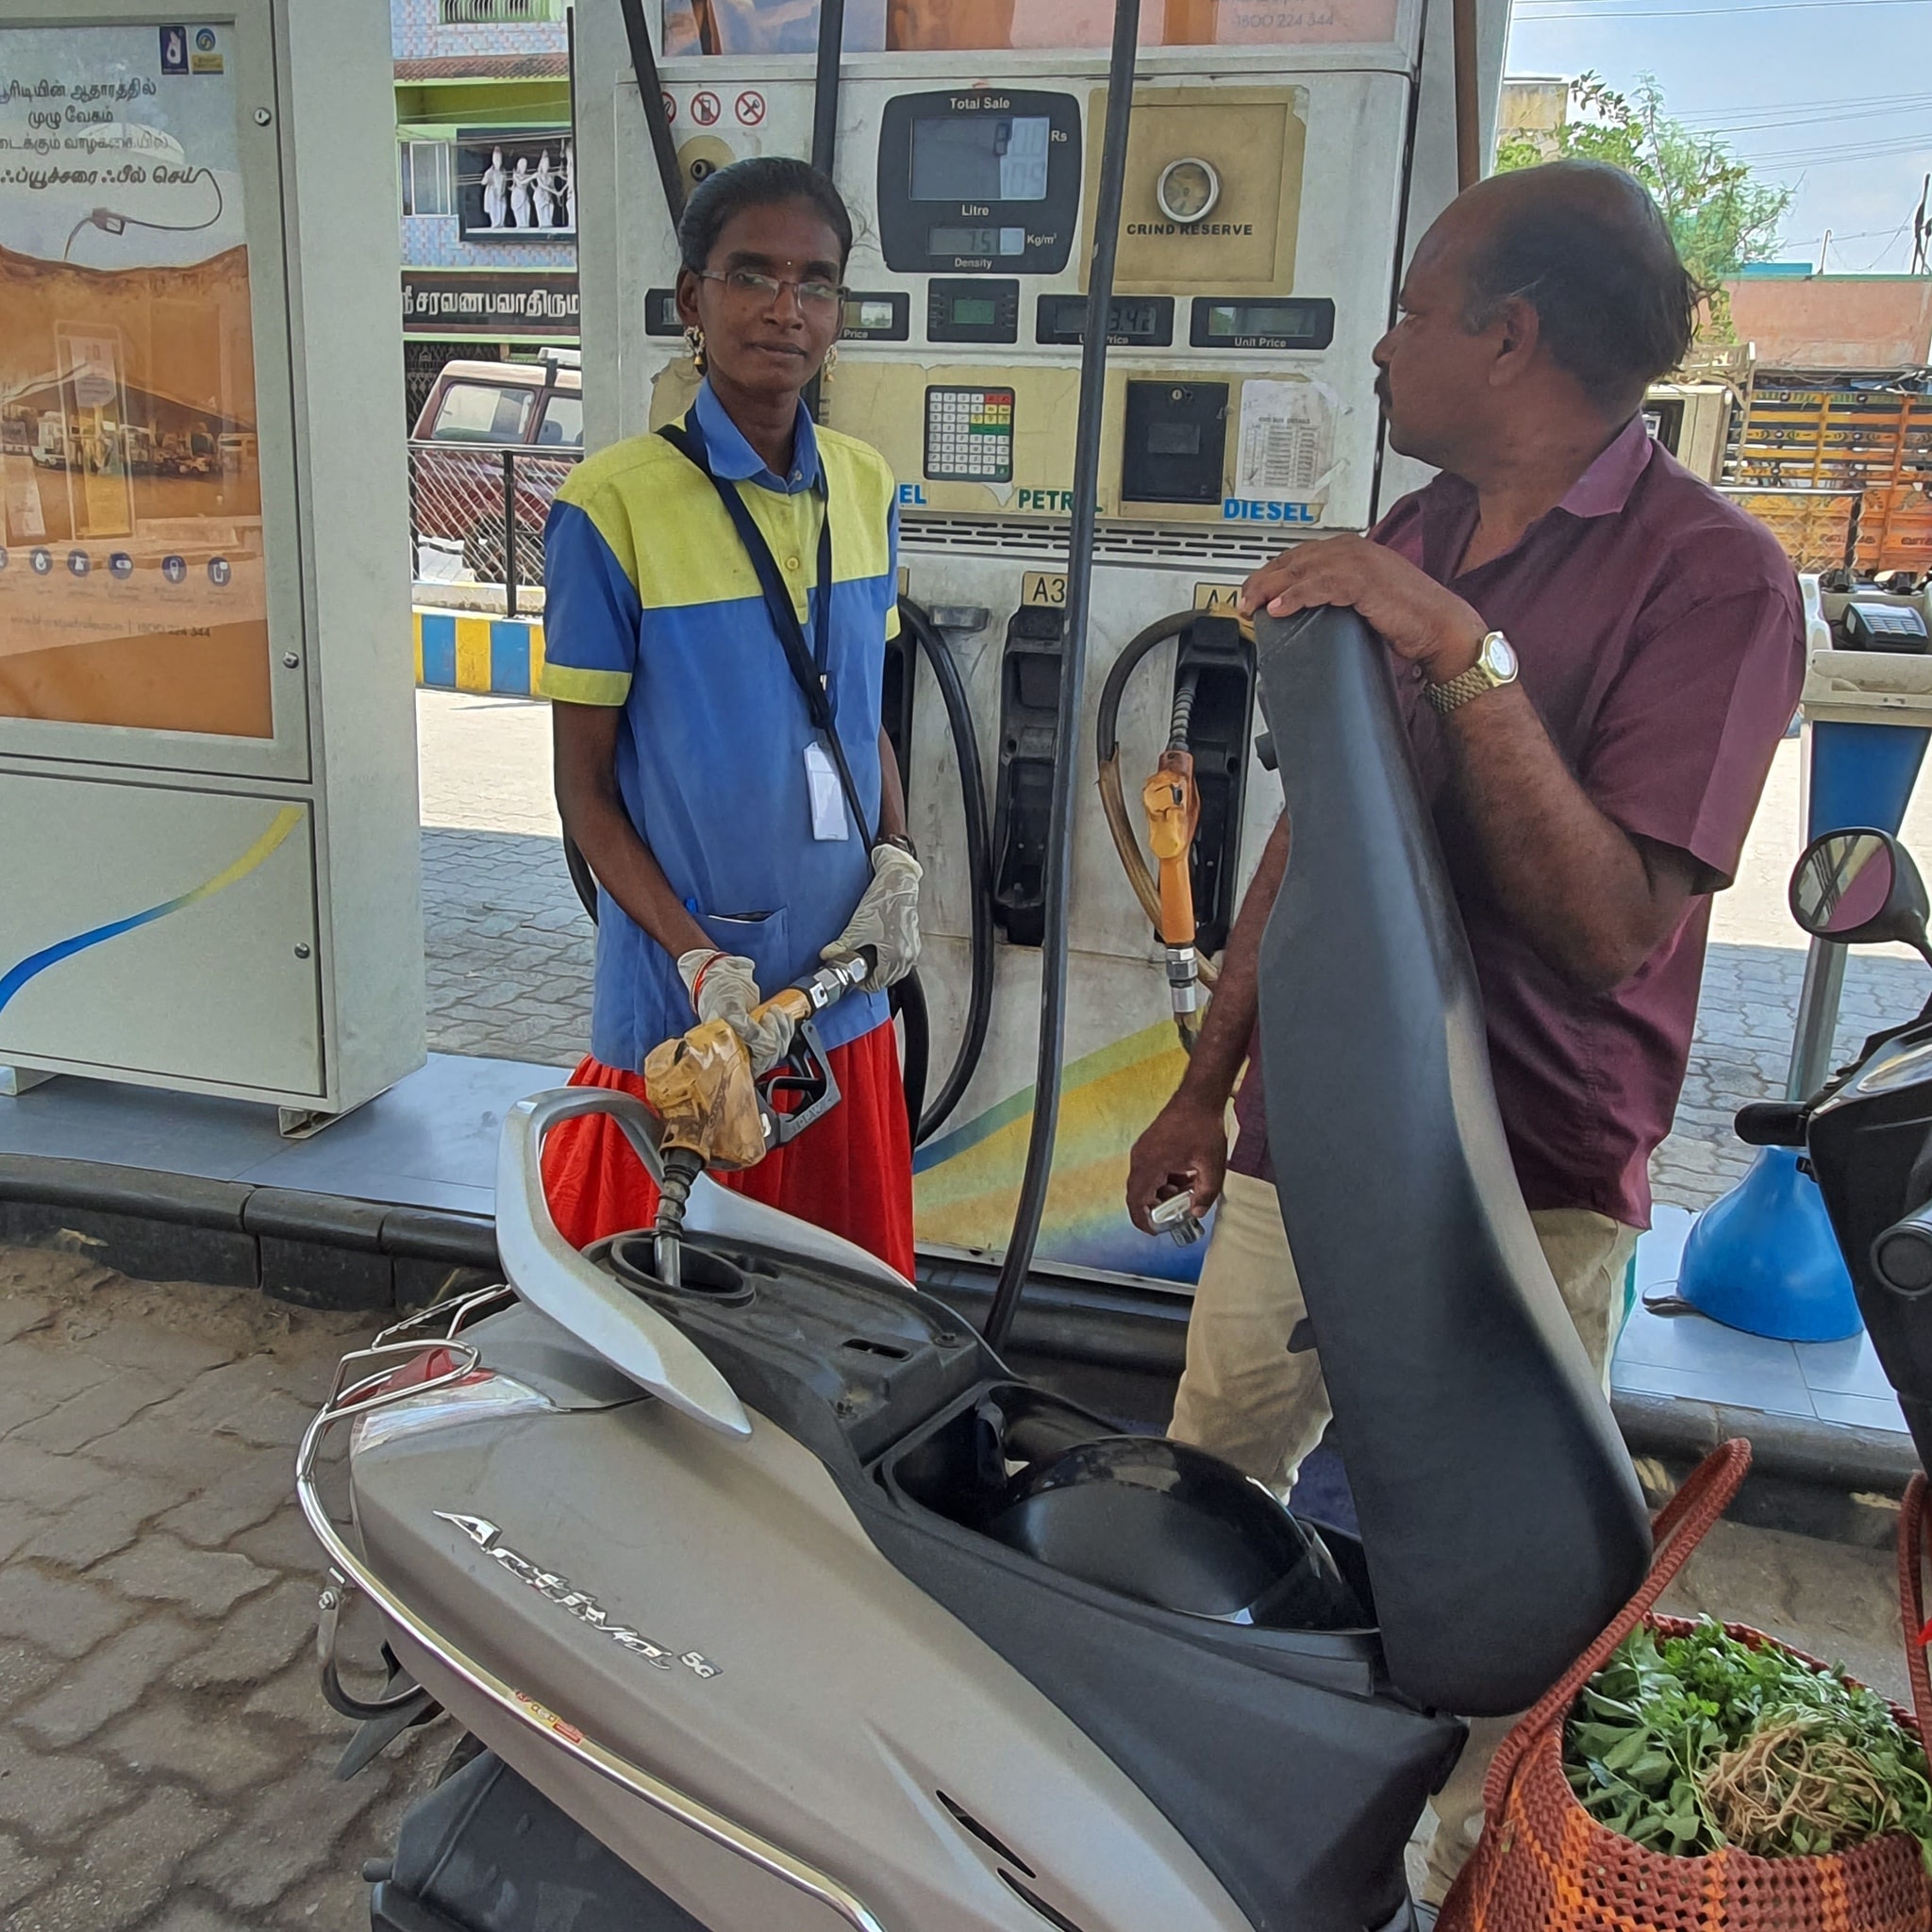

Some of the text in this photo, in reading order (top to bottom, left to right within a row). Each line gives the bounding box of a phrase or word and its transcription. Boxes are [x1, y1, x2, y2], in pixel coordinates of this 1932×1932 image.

[1277, 15, 1303, 27] 224
[70, 77, 157, 102] ஆதாரத்தில்
[950, 97, 1010, 109] Total Sale
[27, 105, 114, 129] முழு வேகம்
[1051, 130, 1068, 142] Rs
[961, 205, 990, 216] Litre
[1179, 224, 1253, 235] RESERVE
[954, 258, 992, 270] Density
[843, 330, 869, 340] Price
[1107, 334, 1129, 344] rice
[1235, 337, 1287, 347] Unit Price
[1019, 489, 1104, 512] PETR
[1224, 499, 1314, 522] DIESEL
[1032, 576, 1066, 604] A3
[432, 1509, 724, 1680] Activa 5G
